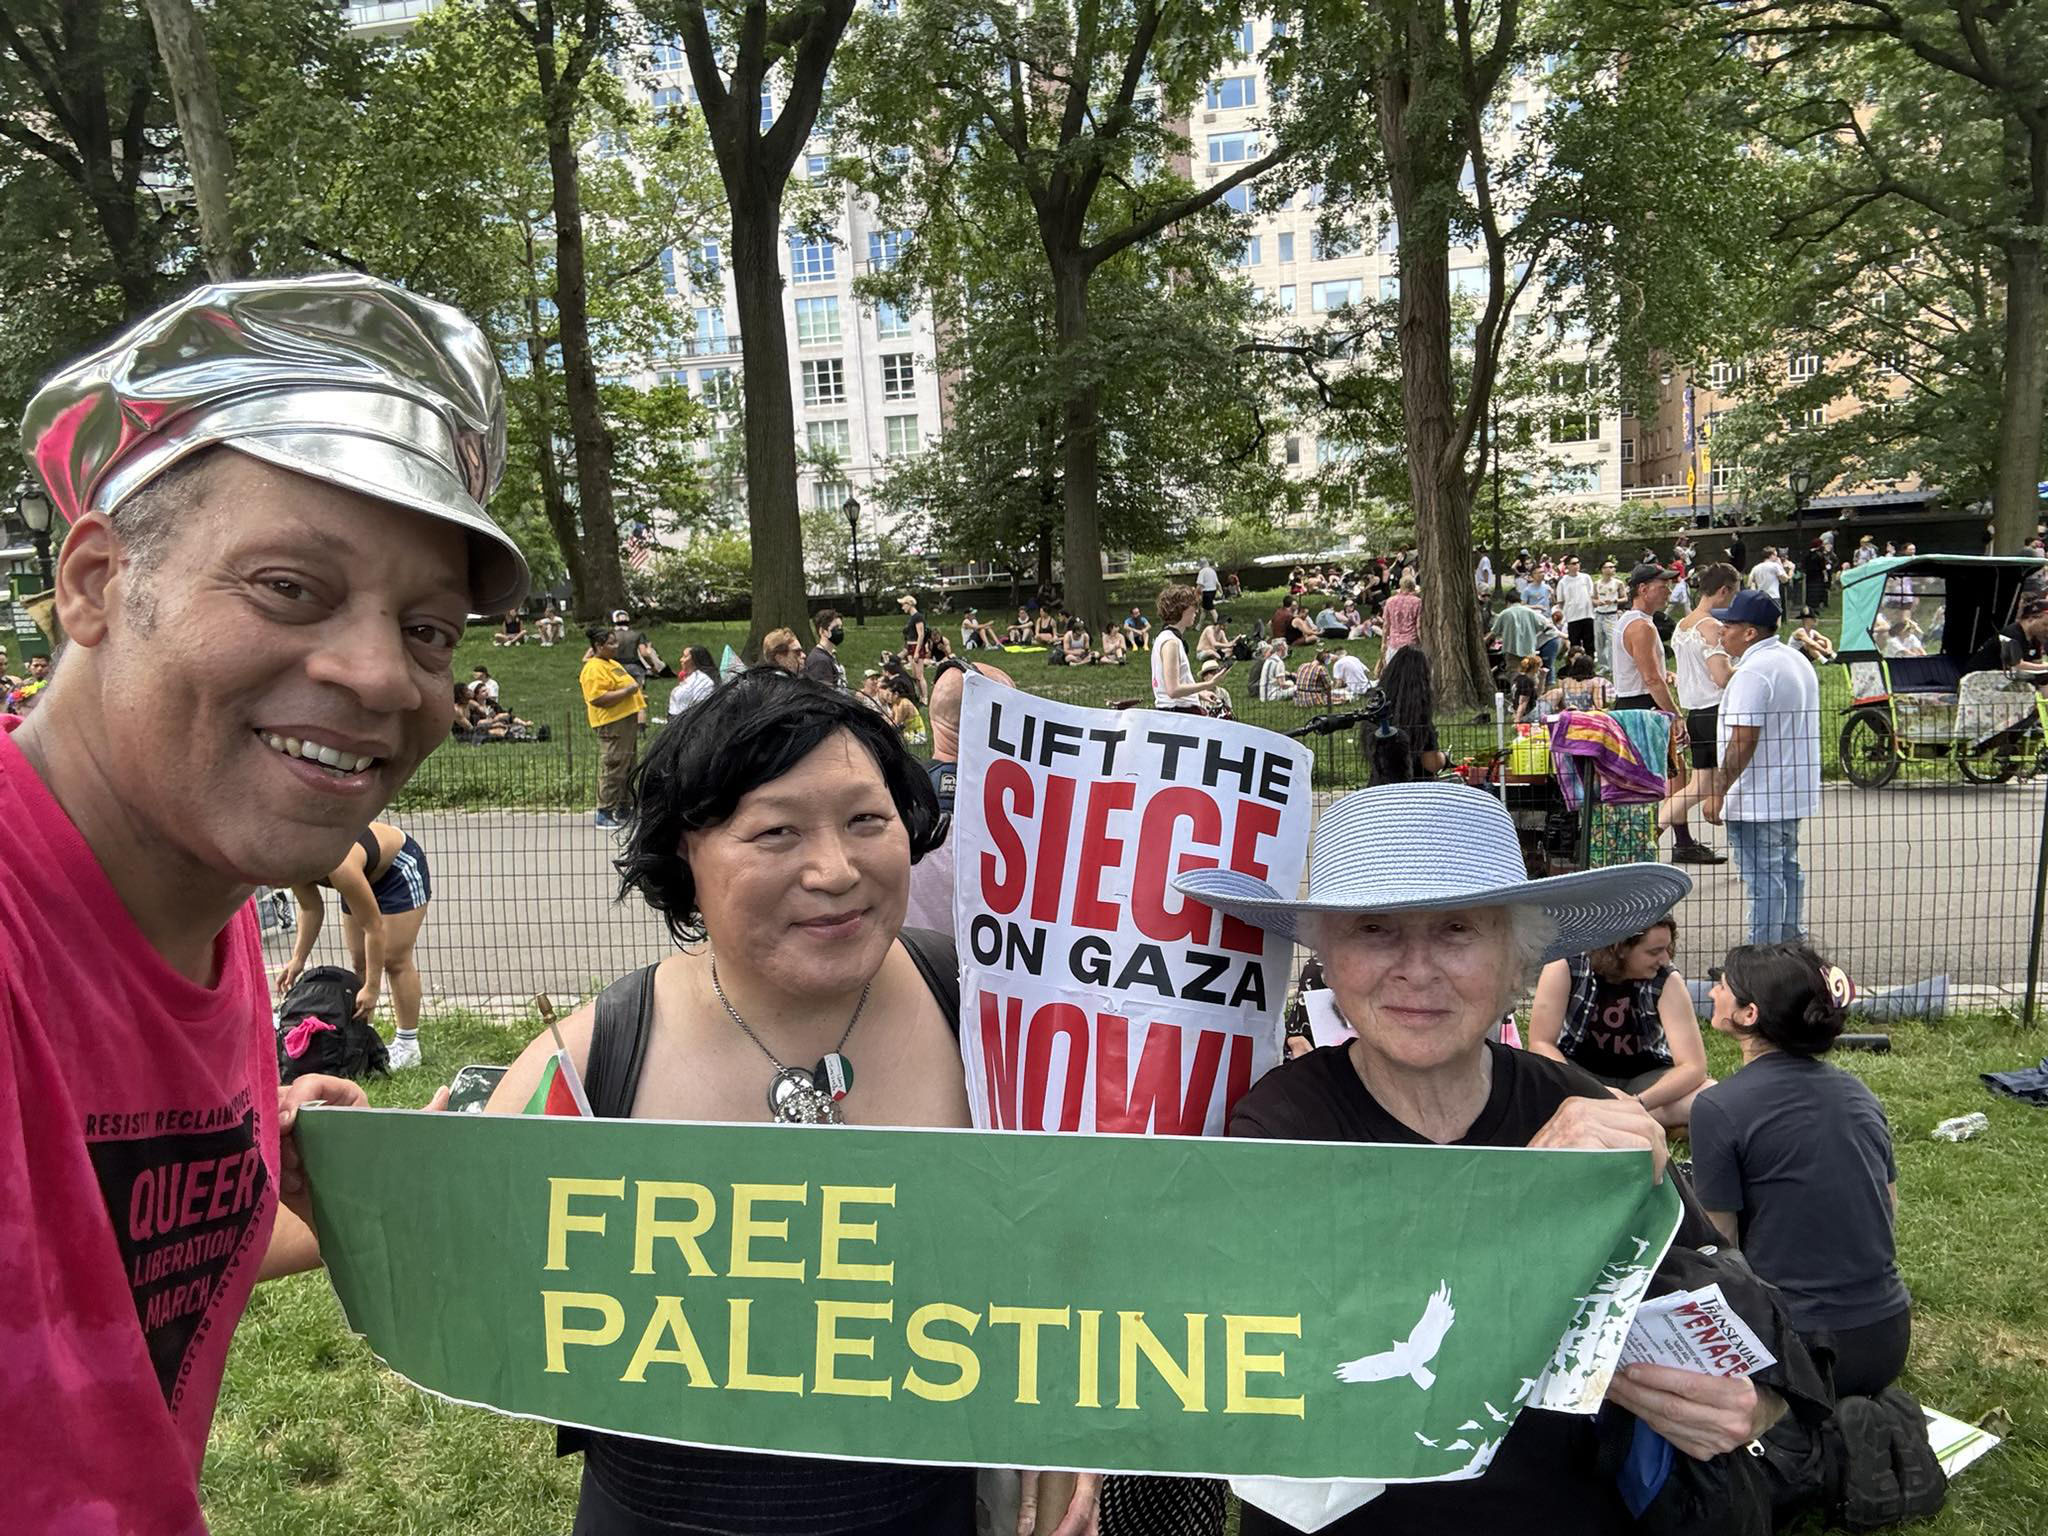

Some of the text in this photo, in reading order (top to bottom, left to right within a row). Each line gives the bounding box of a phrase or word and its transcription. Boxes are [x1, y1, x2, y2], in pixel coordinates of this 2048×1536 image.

[988, 702, 1293, 805] LIFT THE
[980, 758, 1281, 956] SIEGE
[970, 914, 1267, 1012] ON GAZA
[129, 1147, 260, 1241] QUEER
[544, 1176, 896, 1285] FREE
[133, 1225, 239, 1287] LIBERATION
[145, 1274, 211, 1333] MARCH
[542, 1289, 1305, 1421] PALESTINE
[1671, 1301, 1751, 1378] MENACE
[1699, 1294, 1760, 1367] TRANSEXUAL
